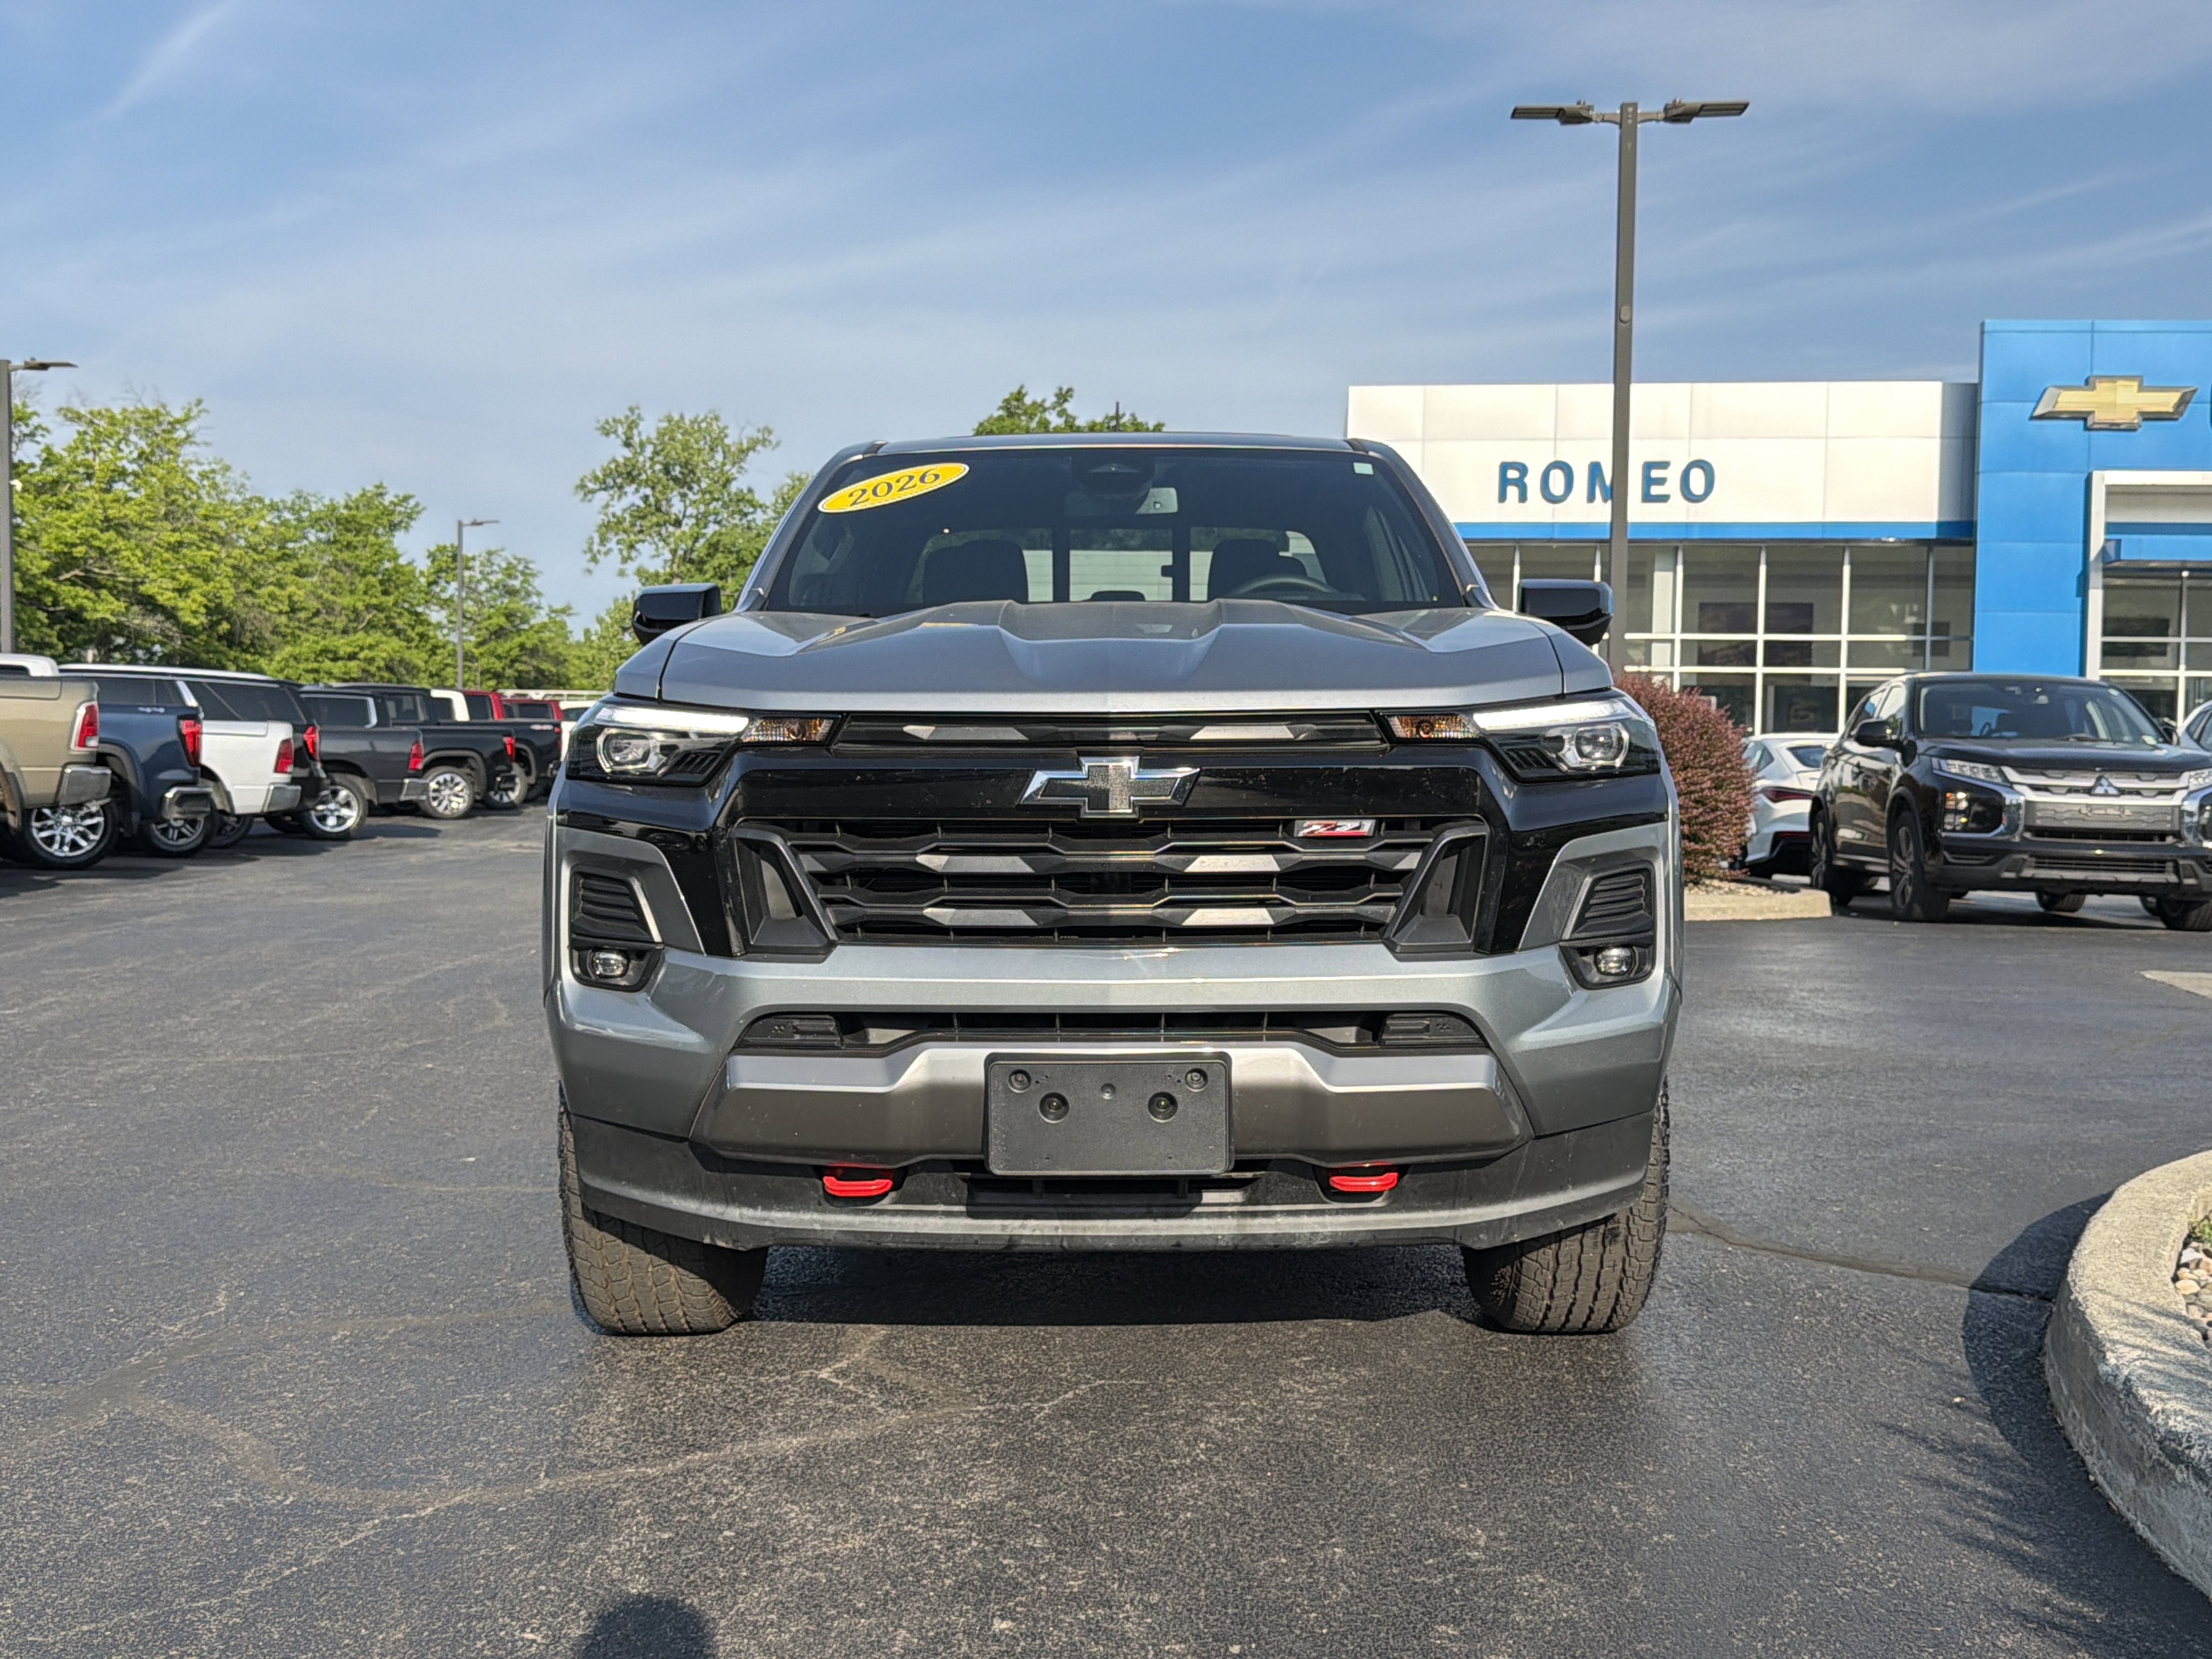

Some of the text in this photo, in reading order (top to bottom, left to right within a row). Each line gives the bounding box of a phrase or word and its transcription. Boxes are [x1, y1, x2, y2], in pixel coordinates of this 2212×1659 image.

[848, 466, 940, 507] 2026
[1498, 459, 1716, 504] ROMEO
[1298, 820, 1373, 837] Z71
